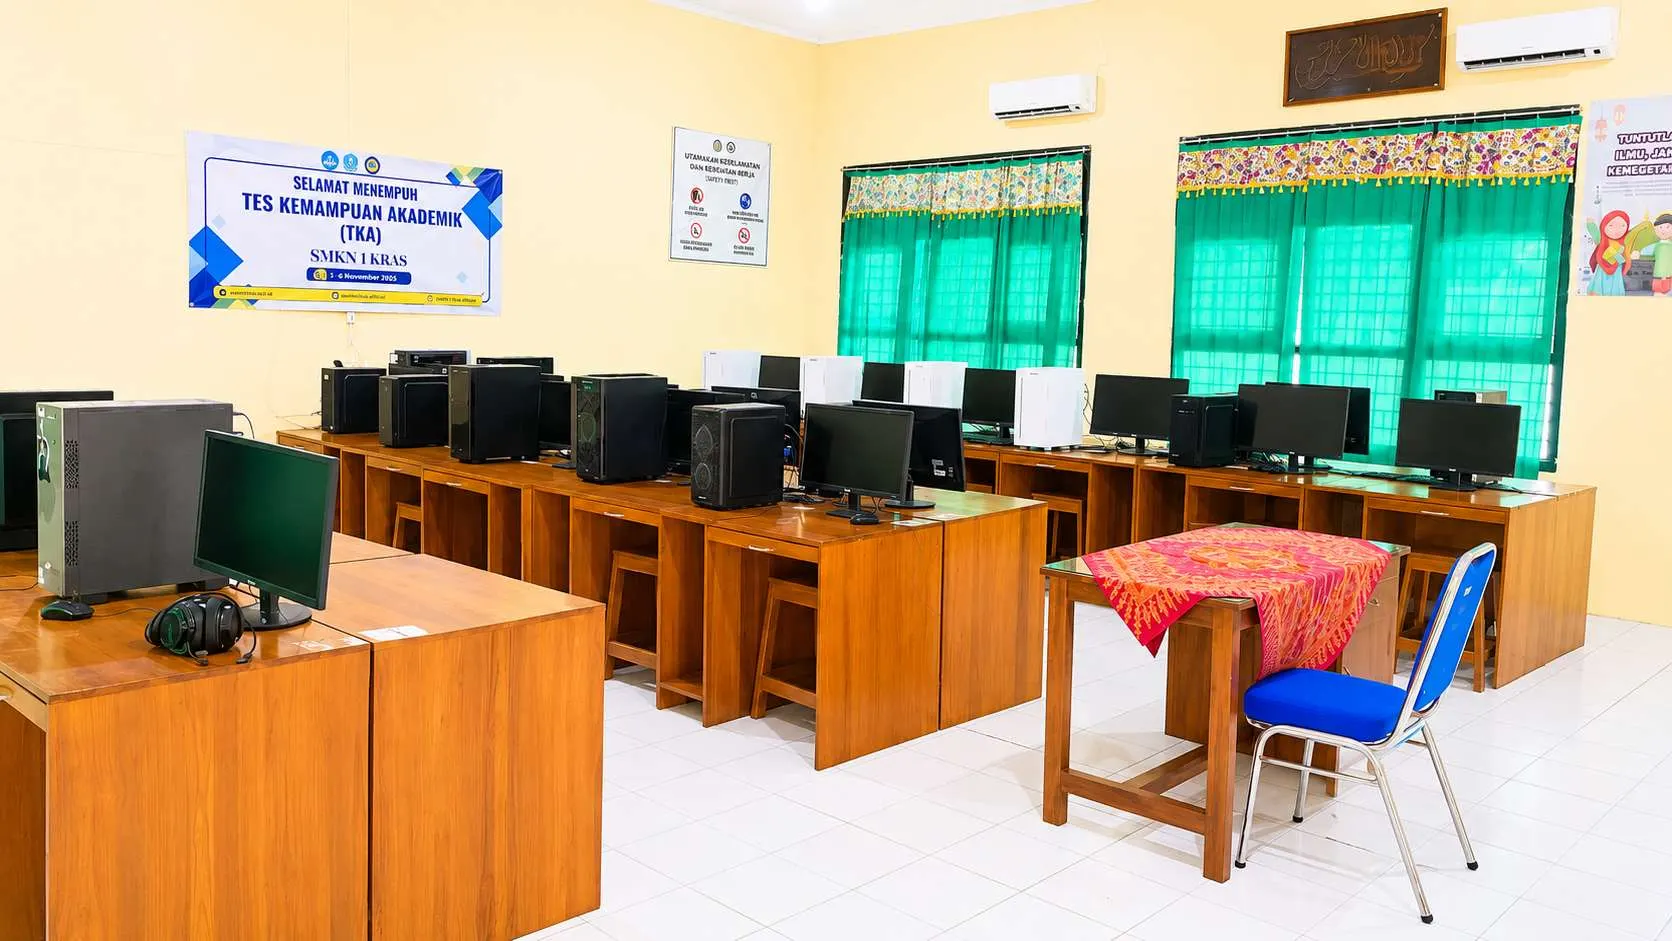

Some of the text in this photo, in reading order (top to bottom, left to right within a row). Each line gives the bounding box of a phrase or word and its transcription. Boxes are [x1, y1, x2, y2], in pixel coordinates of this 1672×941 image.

[1614, 148, 1649, 162] ILMU,
[293, 175, 418, 202] SELAMAT MENEMPUH
[242, 192, 463, 228] TES KEMAMPUAN AKADEMIK
[340, 224, 382, 246] (TKA)
[310, 249, 407, 267] SMKN 1 KRAS
